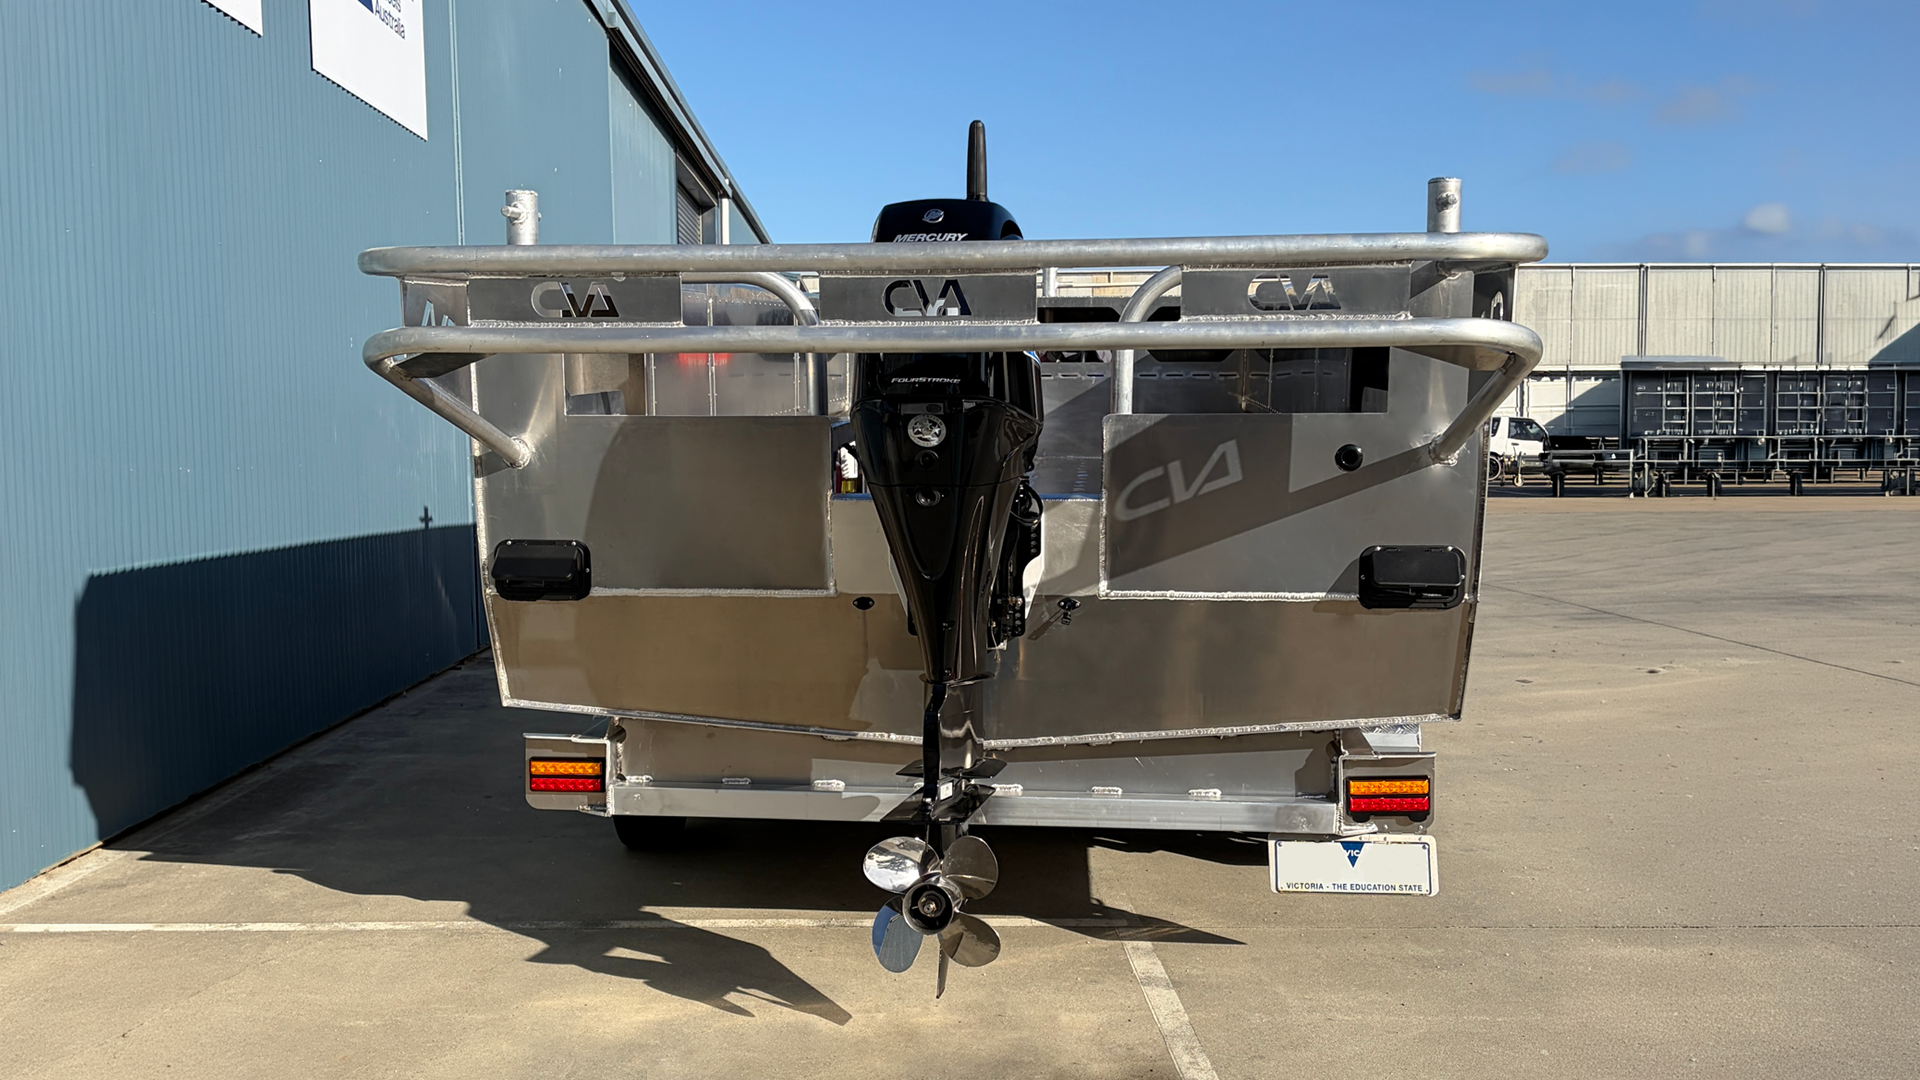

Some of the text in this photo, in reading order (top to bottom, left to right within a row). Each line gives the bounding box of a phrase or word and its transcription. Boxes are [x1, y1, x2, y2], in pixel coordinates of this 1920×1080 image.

[375, 0, 405, 40] Australia
[893, 233, 968, 243] MERCURY
[531, 281, 619, 318] CVA
[883, 279, 971, 316] CVA
[1247, 273, 1342, 311] CVA
[1332, 883, 1347, 891] THE
